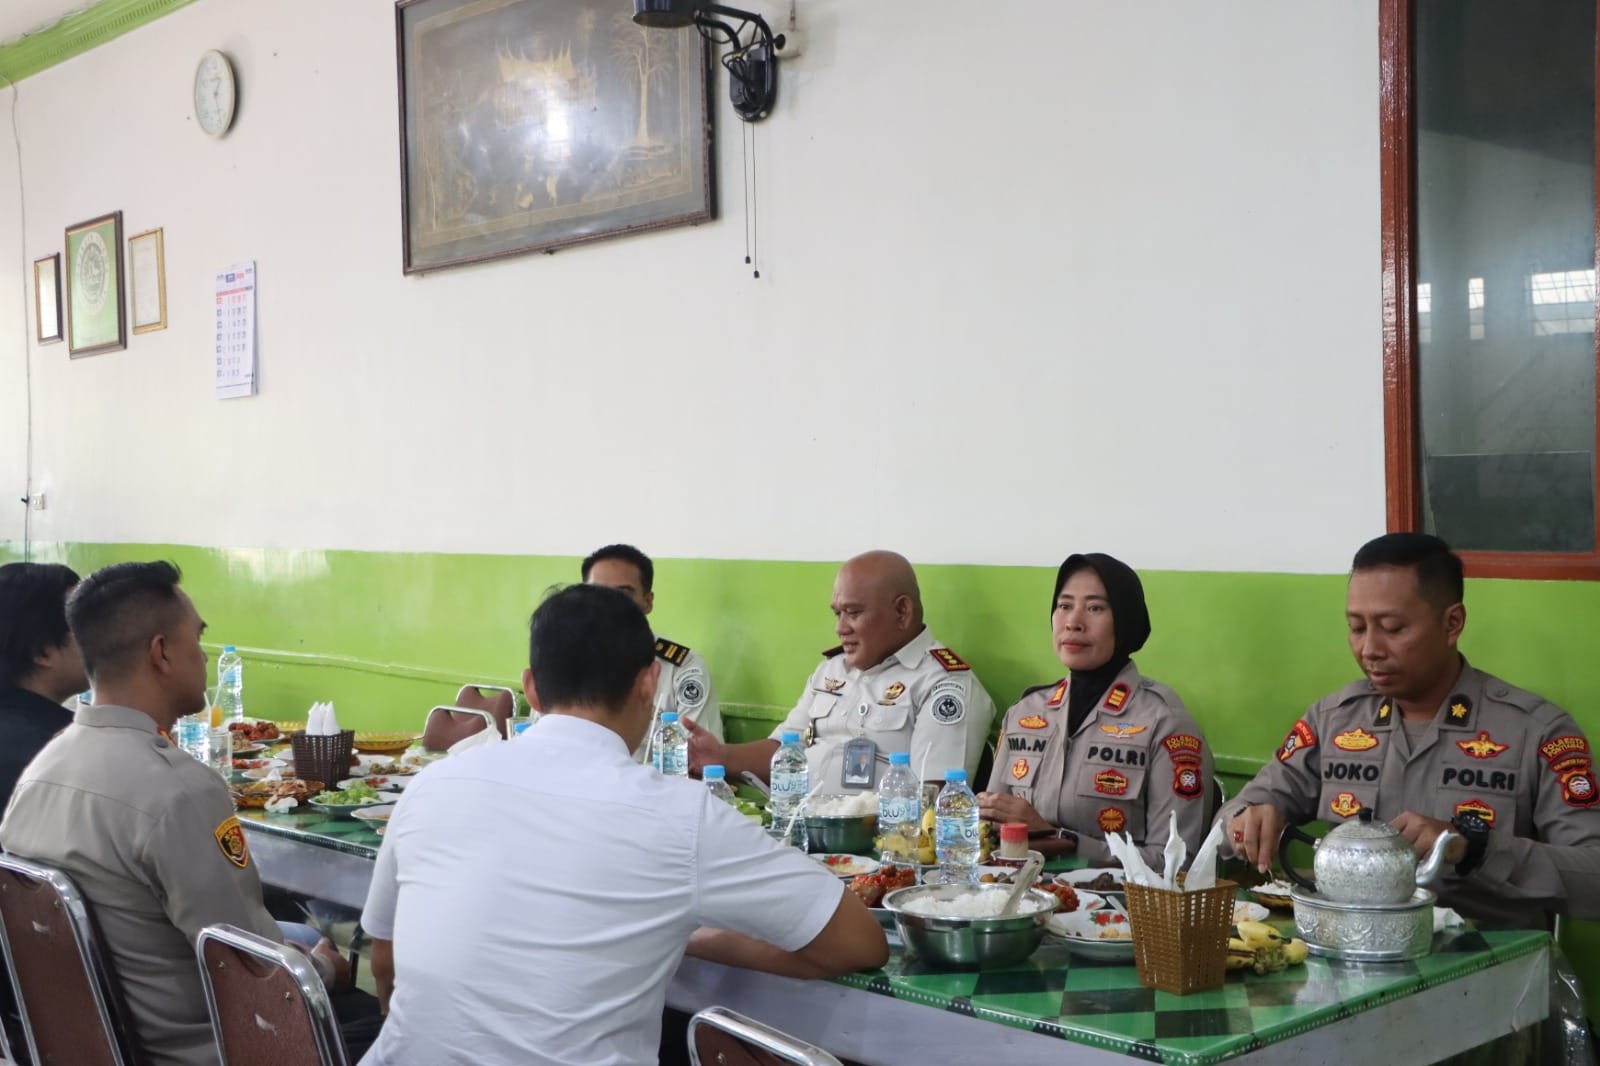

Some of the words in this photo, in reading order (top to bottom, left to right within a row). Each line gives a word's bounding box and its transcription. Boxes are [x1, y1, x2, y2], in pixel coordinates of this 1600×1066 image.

[1087, 746, 1146, 767] POLRI
[1323, 762, 1380, 782] JOKO
[1442, 767, 1517, 791] POLRI
